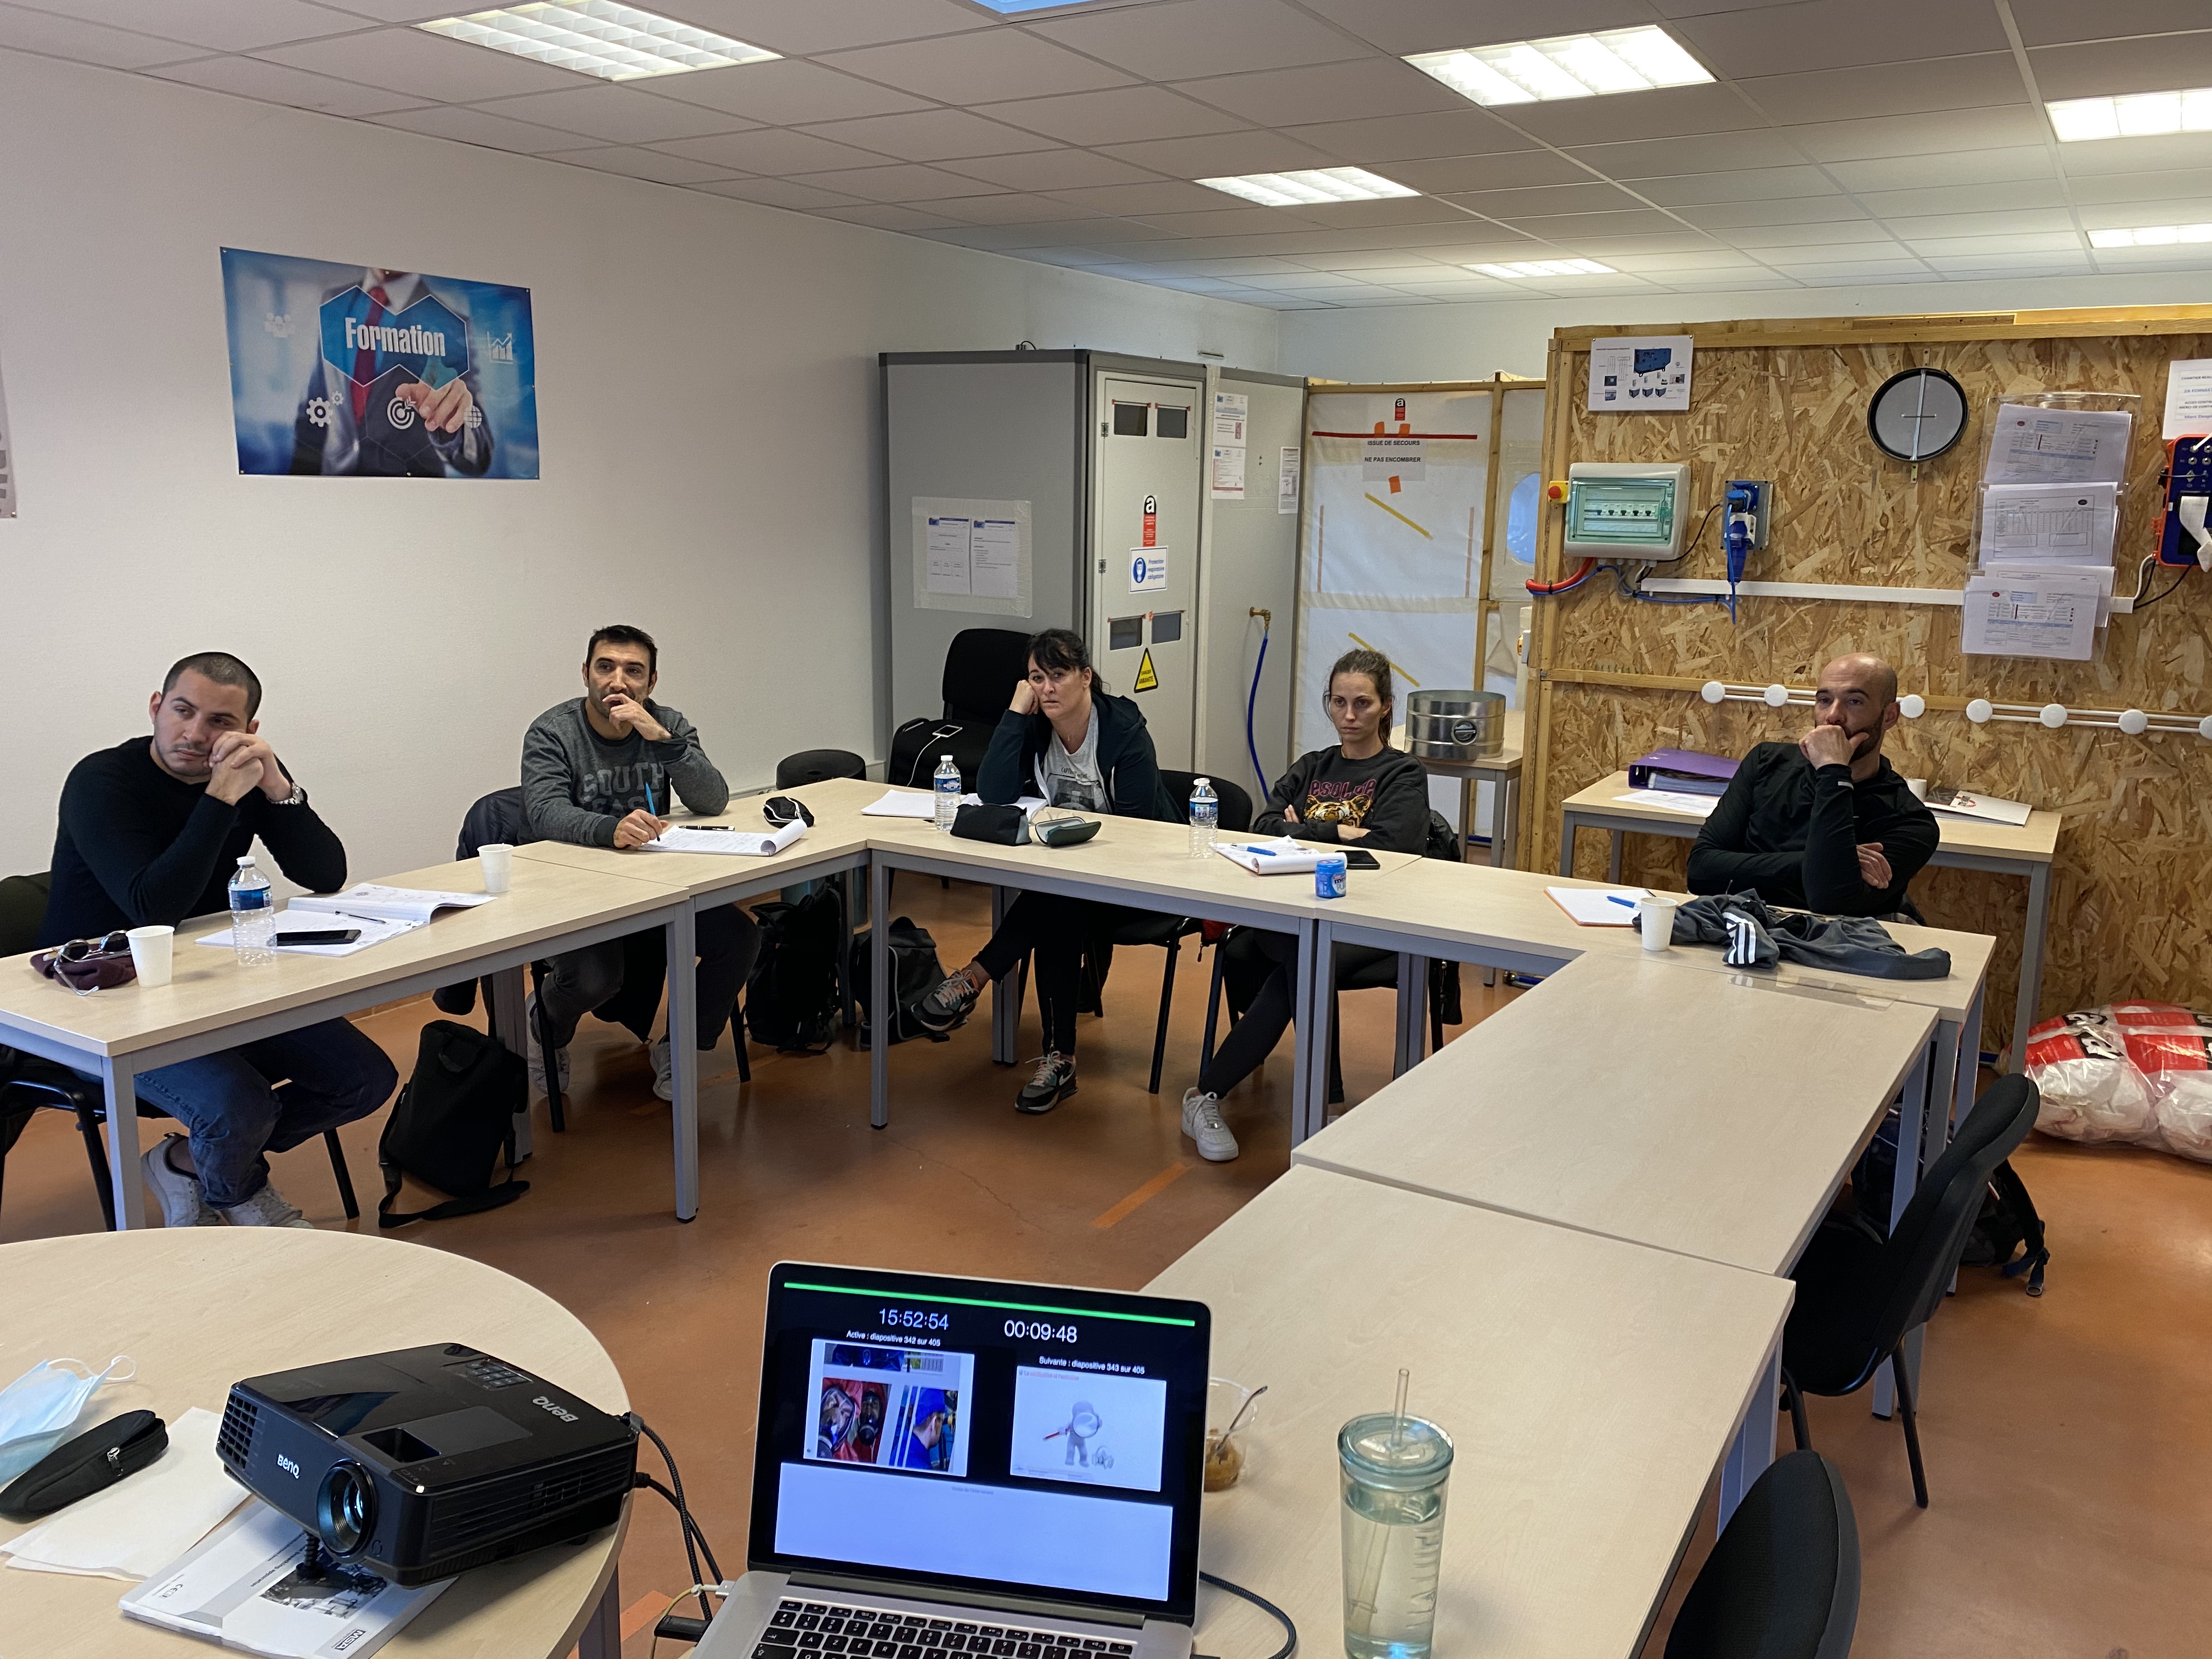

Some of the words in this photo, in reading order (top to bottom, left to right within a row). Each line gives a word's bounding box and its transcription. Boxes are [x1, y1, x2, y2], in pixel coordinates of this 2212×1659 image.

[345, 317, 445, 356] Formation
[581, 761, 664, 803] SOUTH
[879, 1308, 949, 1330] 15:52:54
[1004, 1319, 1077, 1343] 00:09:48
[847, 1330, 866, 1339] Active
[870, 1333, 903, 1343] diapositive
[904, 1336, 916, 1344] 342
[928, 1338, 941, 1347] 405
[1039, 1356, 1067, 1367] Suivante
[1071, 1359, 1105, 1370] diapositive
[1107, 1363, 1119, 1372] 343
[1120, 1365, 1131, 1373] sur
[1132, 1365, 1145, 1374] 405
[533, 1396, 579, 1423] BenQ
[277, 1454, 300, 1479] BenQ
[335, 1630, 364, 1650] MSA
